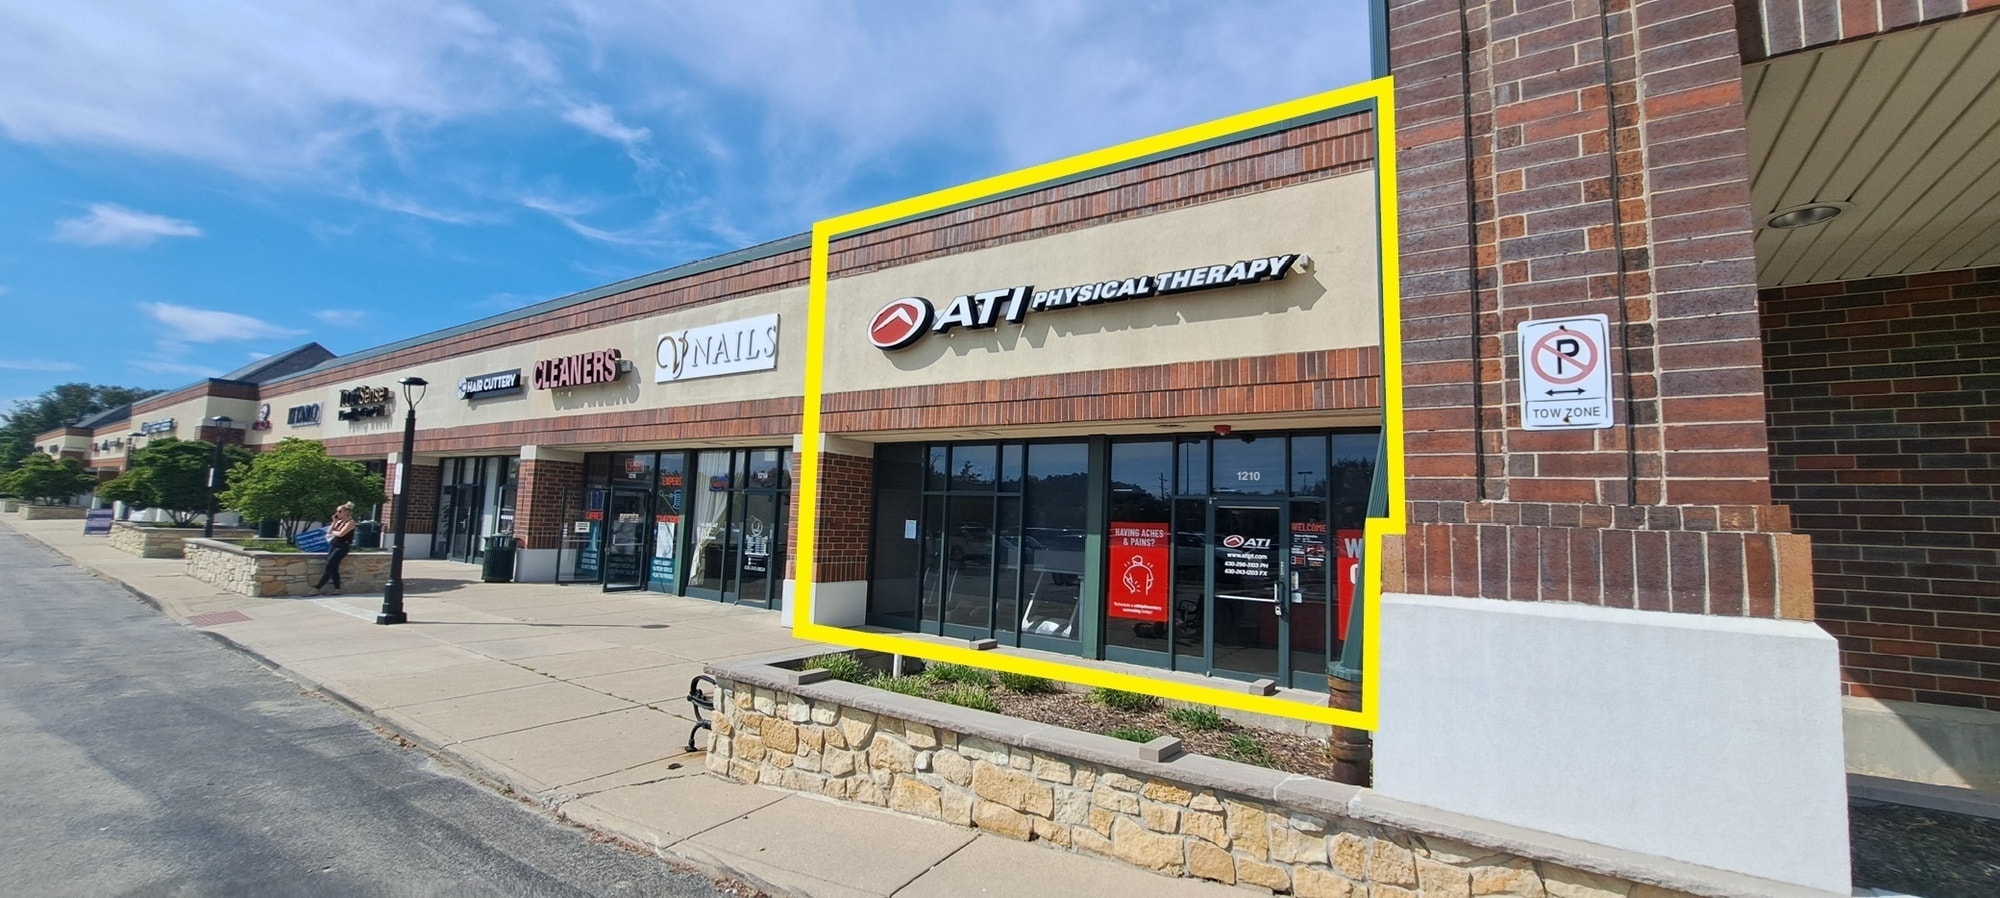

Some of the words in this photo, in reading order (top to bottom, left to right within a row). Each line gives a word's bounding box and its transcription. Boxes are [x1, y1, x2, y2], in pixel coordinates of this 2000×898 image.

[932, 286, 1026, 331] ATI
[1032, 276, 1150, 308] PHYSICAL
[1157, 255, 1291, 291] THERAPY
[692, 326, 777, 367] NAILS
[533, 348, 616, 390] CLEANERS
[467, 379, 483, 393] HAIR
[483, 373, 517, 391] CUTTERY
[1533, 408, 1561, 419] TOW
[1566, 406, 1601, 418] ZONE
[1236, 471, 1261, 482] 1210
[1115, 528, 1140, 537] HAVING
[1141, 529, 1164, 539] ACHES
[1291, 523, 1327, 532] WELCOME
[1122, 538, 1129, 546] &
[1130, 538, 1156, 547] PAINS?
[1244, 538, 1271, 547] ATI
